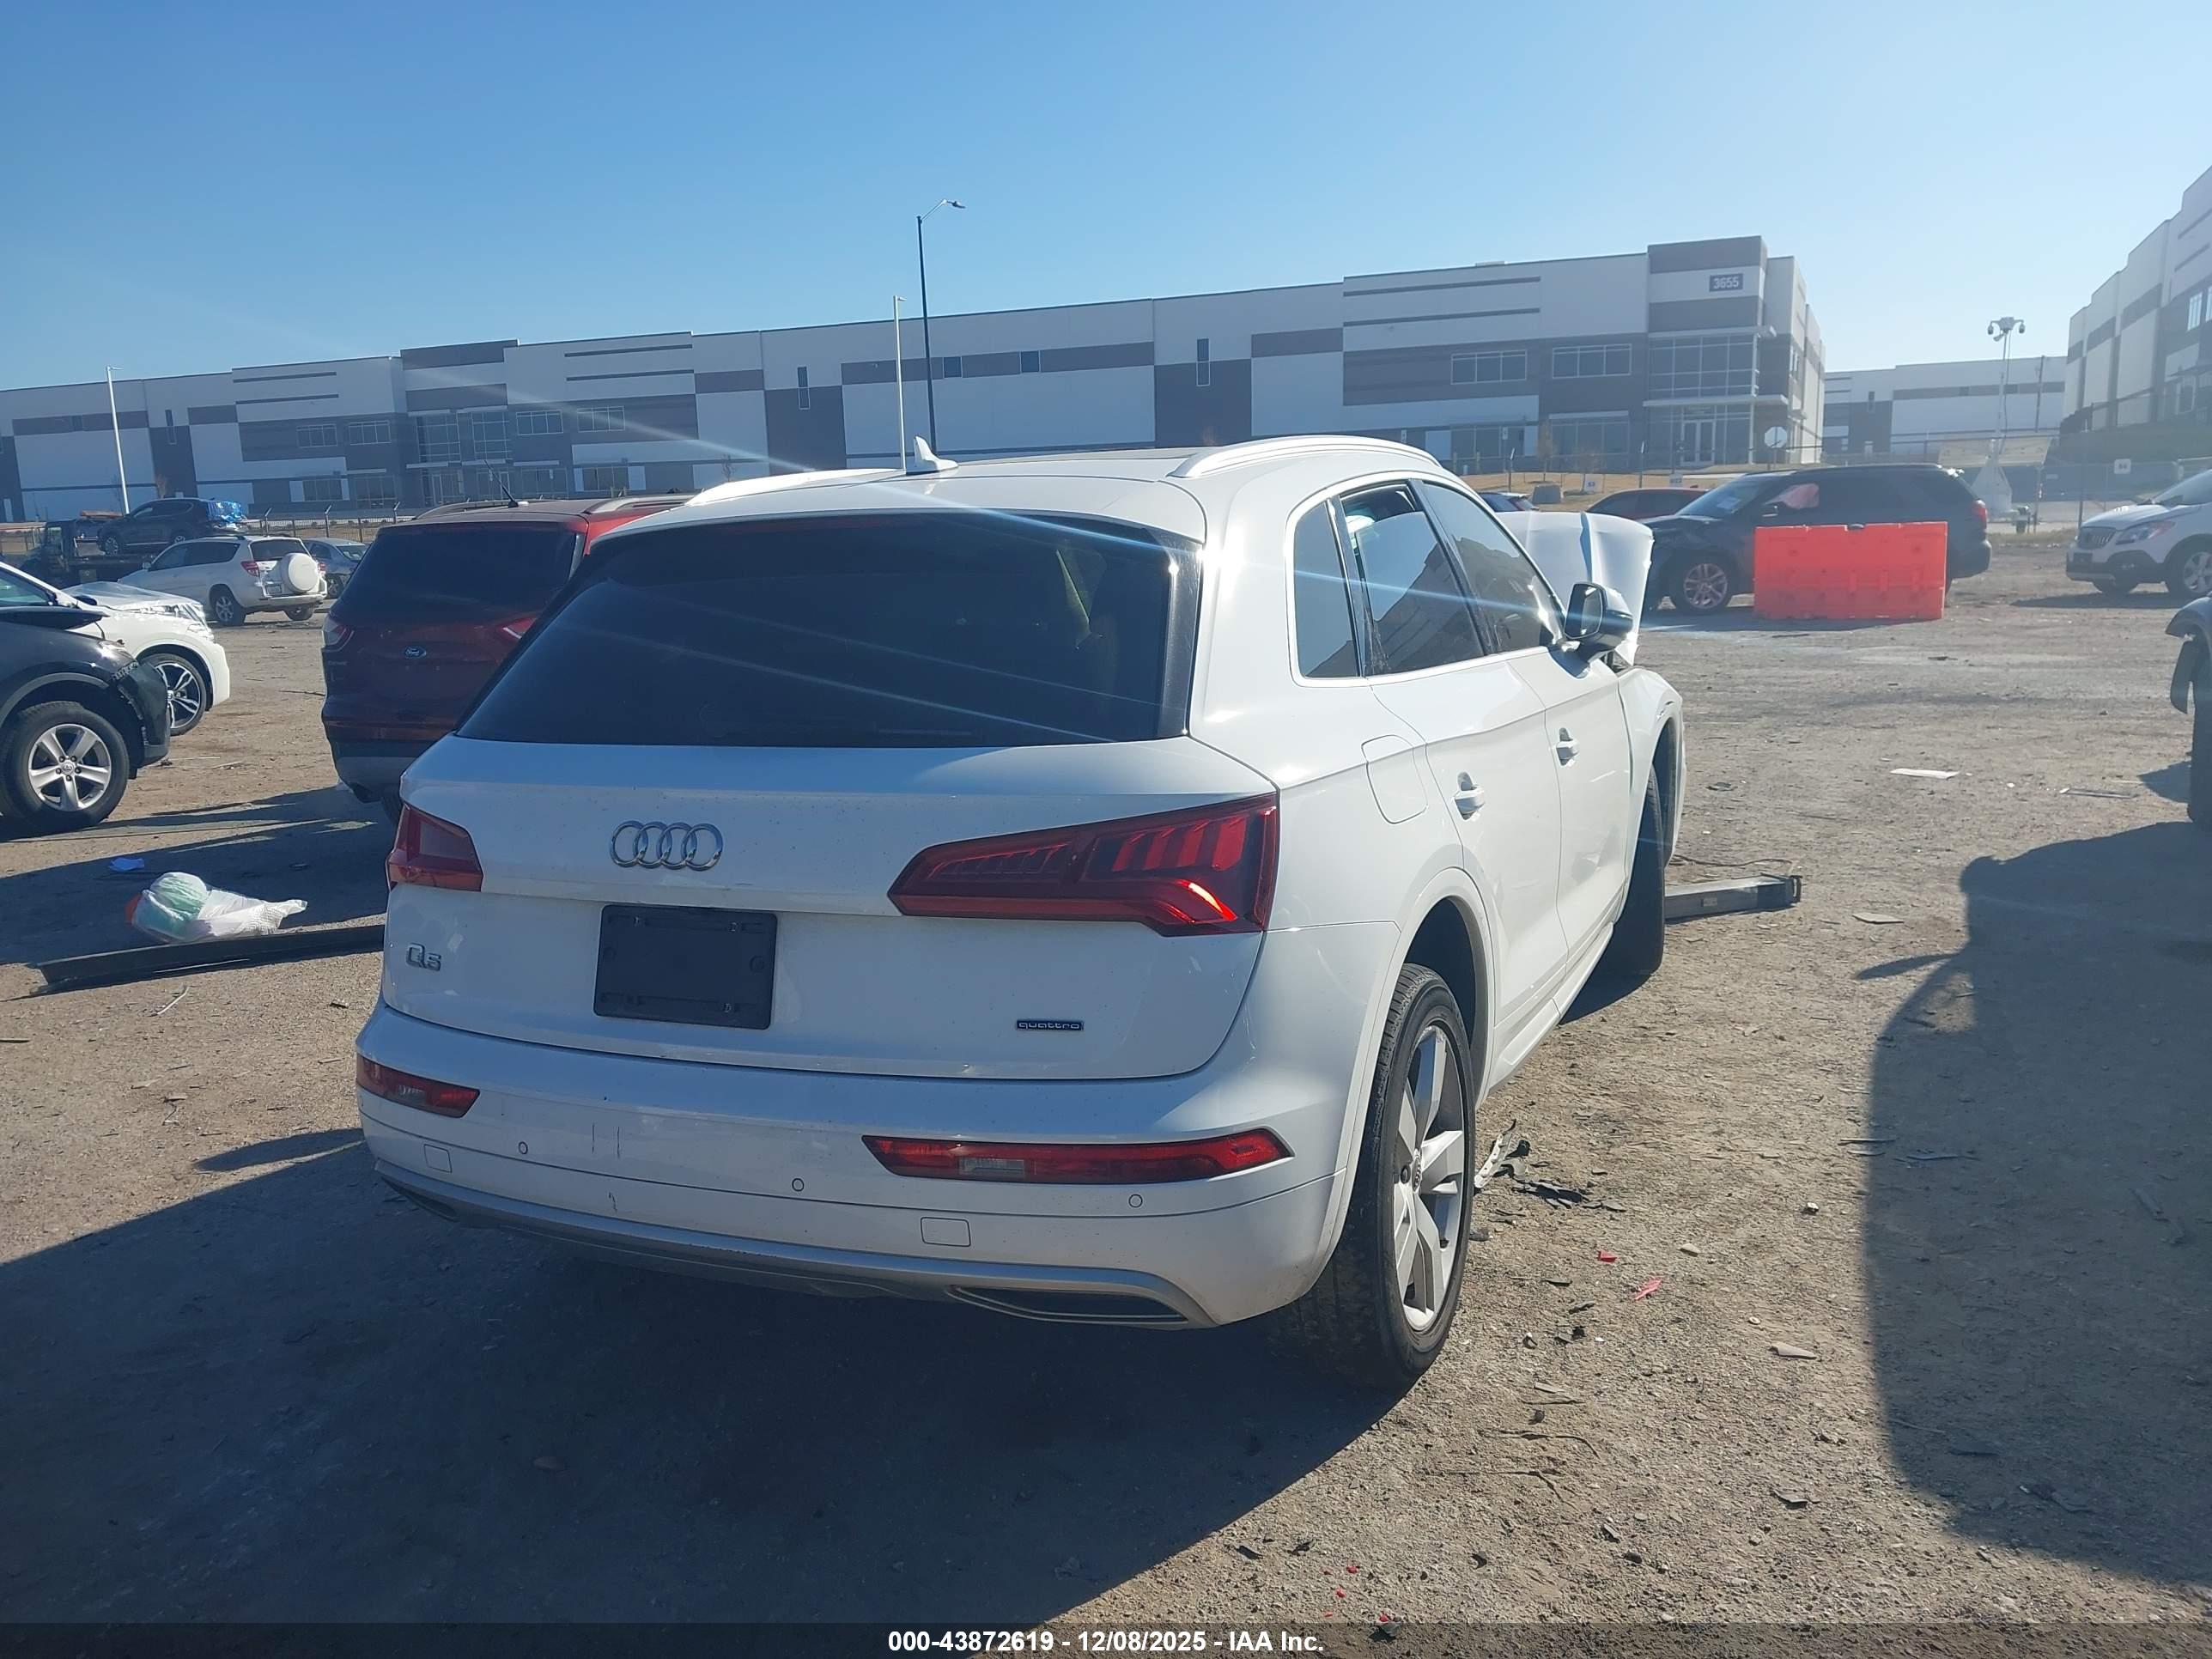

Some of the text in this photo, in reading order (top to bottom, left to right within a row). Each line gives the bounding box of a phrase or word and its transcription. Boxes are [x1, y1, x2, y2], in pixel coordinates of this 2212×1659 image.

[1713, 276, 1739, 289] 3655
[405, 942, 441, 971] Q5
[1018, 1021, 1080, 1030] quattro
